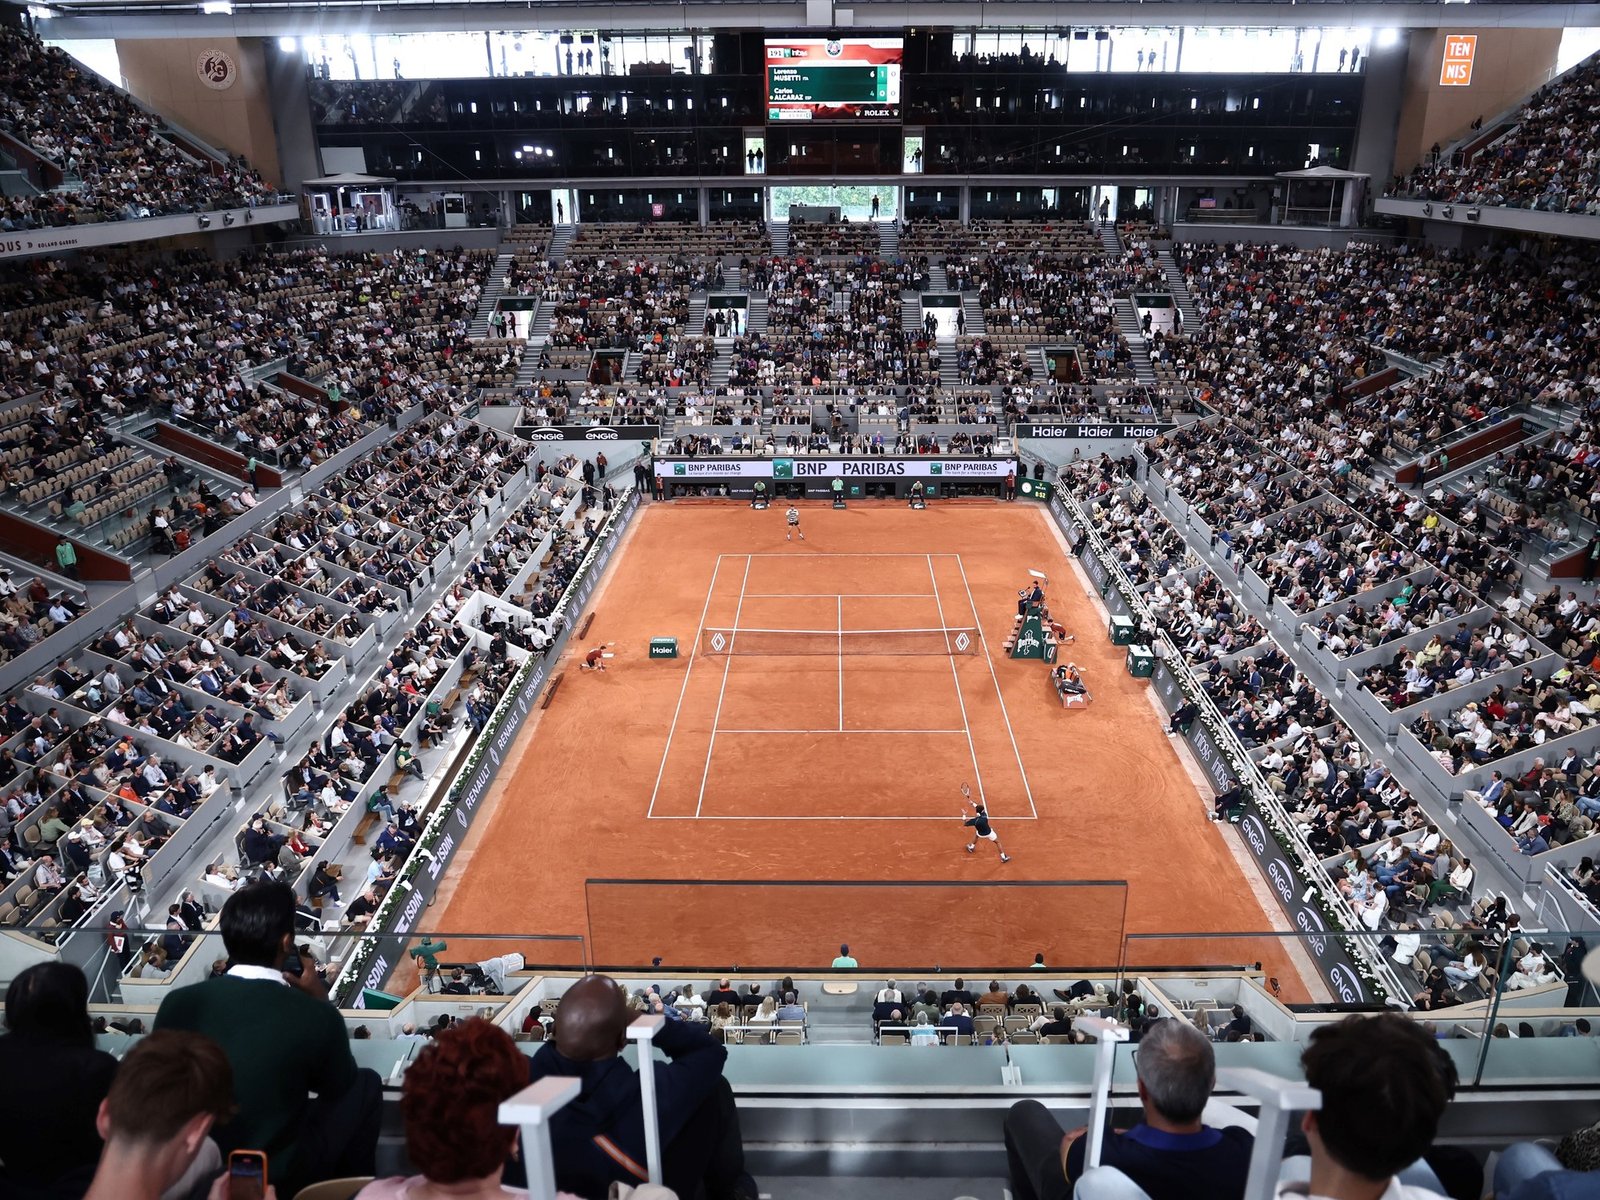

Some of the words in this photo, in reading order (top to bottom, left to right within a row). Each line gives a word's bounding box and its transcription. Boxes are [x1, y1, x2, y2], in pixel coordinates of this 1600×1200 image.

[1450, 42, 1471, 56] TEN
[869, 70, 875, 78] 6
[1446, 64, 1467, 79] NIS
[1032, 426, 1067, 437] Haier
[1078, 426, 1113, 437] Haier
[1123, 426, 1158, 437] Haier
[688, 463, 705, 471] BNP
[707, 463, 741, 471] PARIBAS
[797, 463, 827, 475] BNP
[842, 463, 905, 475] PARIBAS
[944, 463, 961, 471] BNP
[963, 463, 998, 471] PARIBAS
[525, 666, 544, 701] RENAULT
[497, 710, 520, 751] RENAULT
[466, 763, 491, 811] RENAULT
[438, 833, 454, 864] ISDIN
[405, 889, 424, 924] ISDIN
[365, 954, 388, 990] ISDIN
